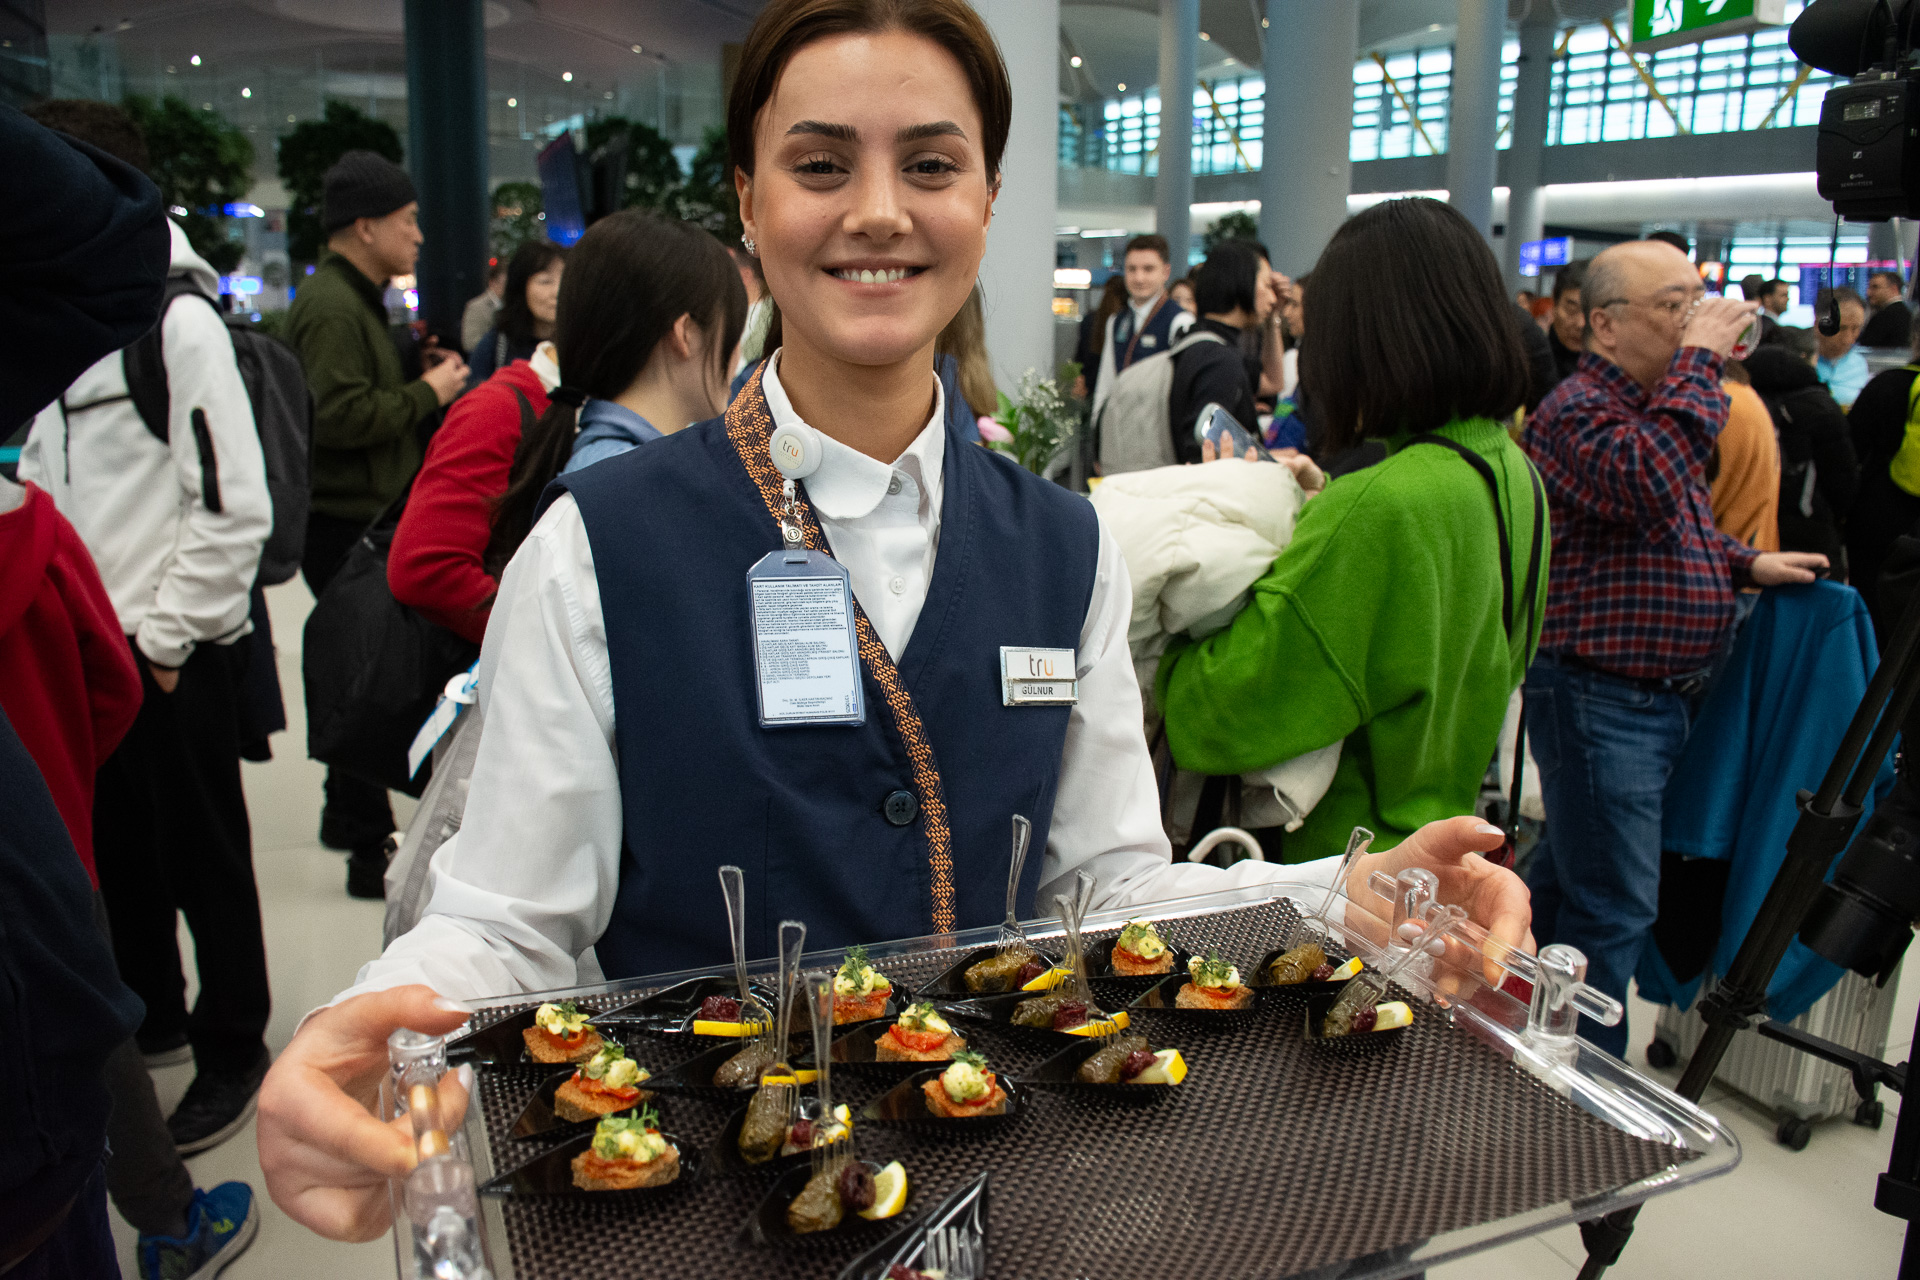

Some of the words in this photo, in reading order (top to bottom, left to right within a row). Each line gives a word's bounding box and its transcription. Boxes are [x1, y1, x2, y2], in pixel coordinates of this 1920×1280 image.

[783, 440, 798, 457] tru
[1029, 654, 1053, 676] tru
[1022, 684, 1053, 695] GÜLNUR
